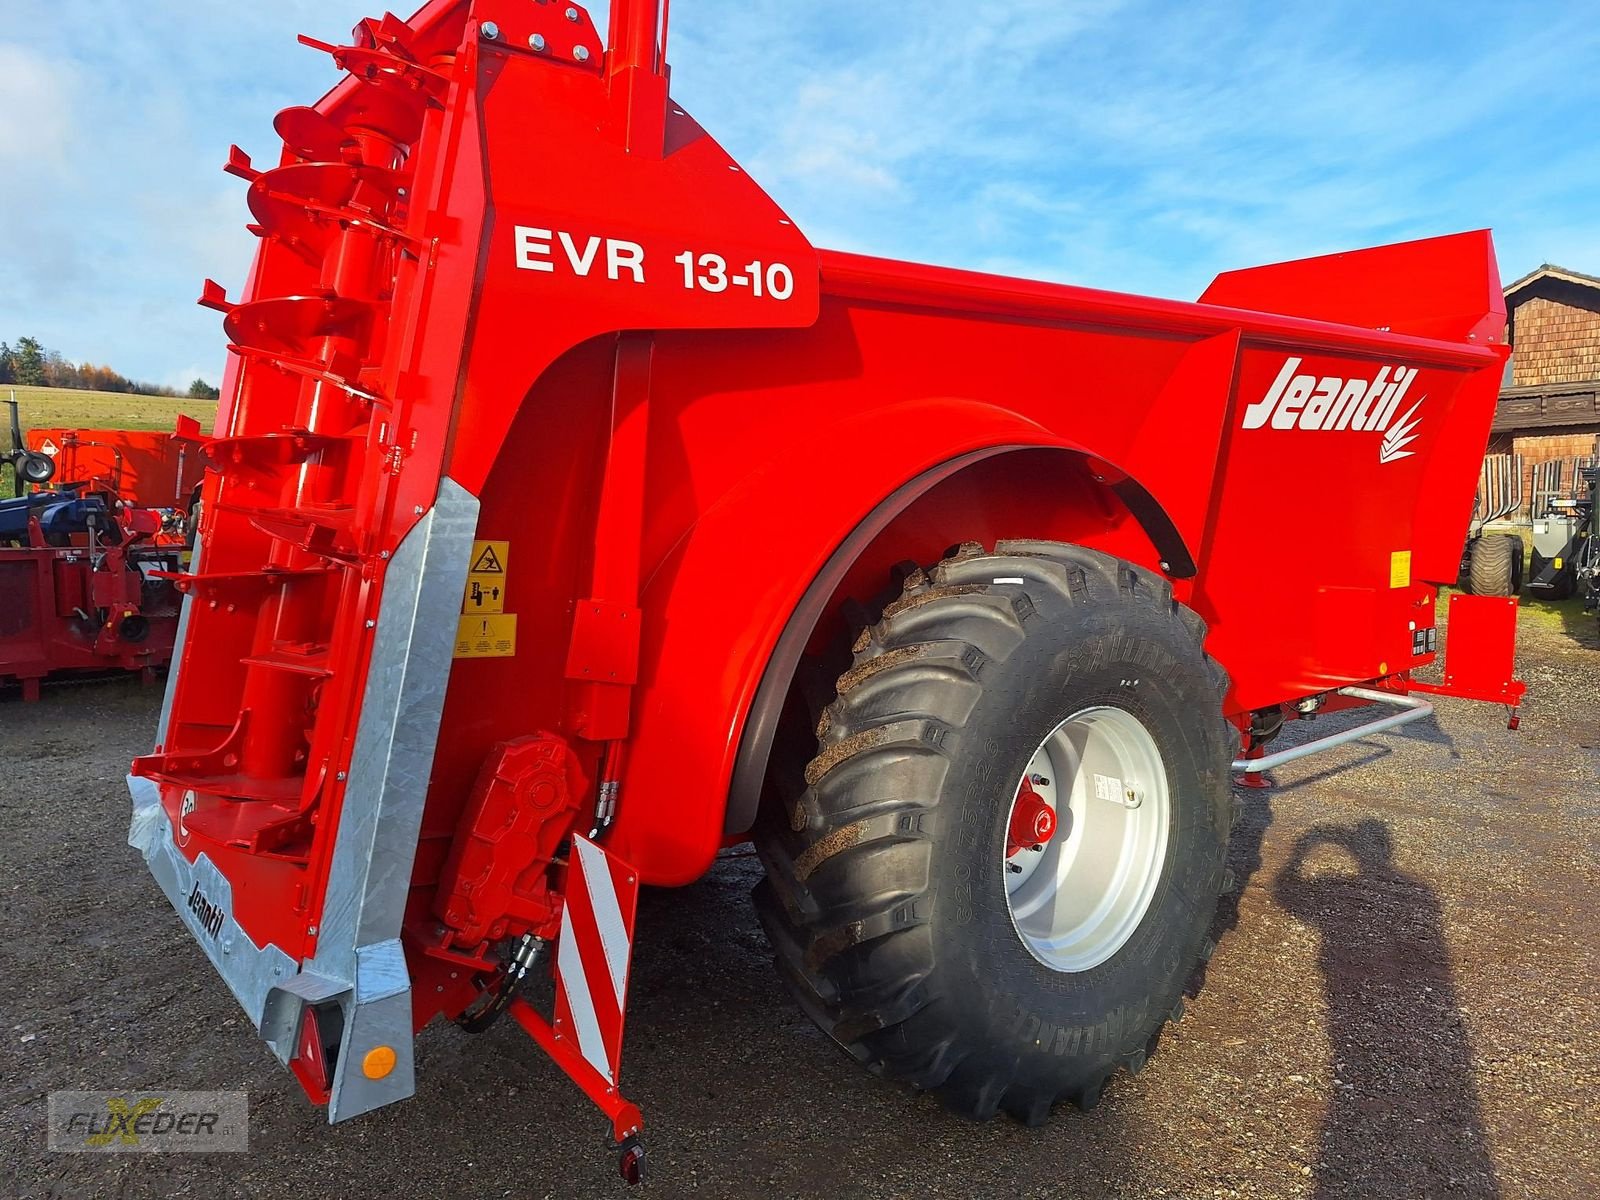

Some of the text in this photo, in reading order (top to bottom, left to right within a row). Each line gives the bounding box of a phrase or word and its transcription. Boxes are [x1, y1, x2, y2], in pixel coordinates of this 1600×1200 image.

[514, 224, 794, 301] EVR 13-10
[1241, 356, 1419, 432] Jeantil
[187, 879, 225, 941] Jeantil
